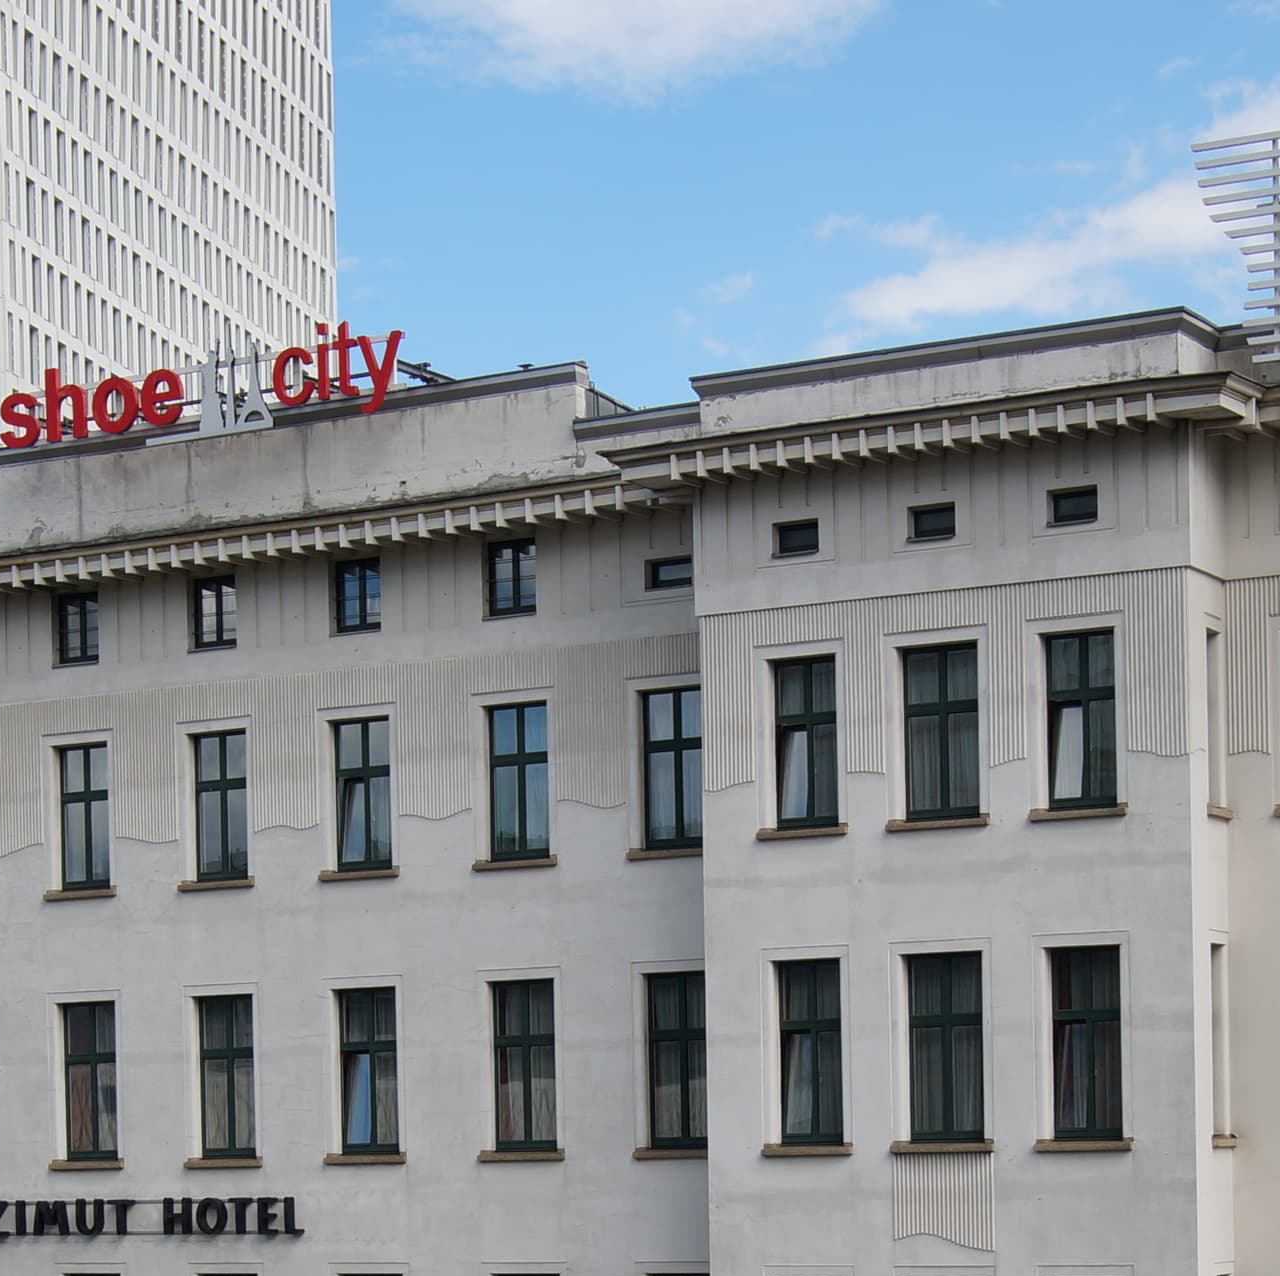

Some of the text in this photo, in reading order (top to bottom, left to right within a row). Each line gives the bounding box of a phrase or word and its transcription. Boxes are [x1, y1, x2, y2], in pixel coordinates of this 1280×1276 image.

[0, 320, 407, 449] shoe city
[162, 1196, 305, 1236] HOTEL
